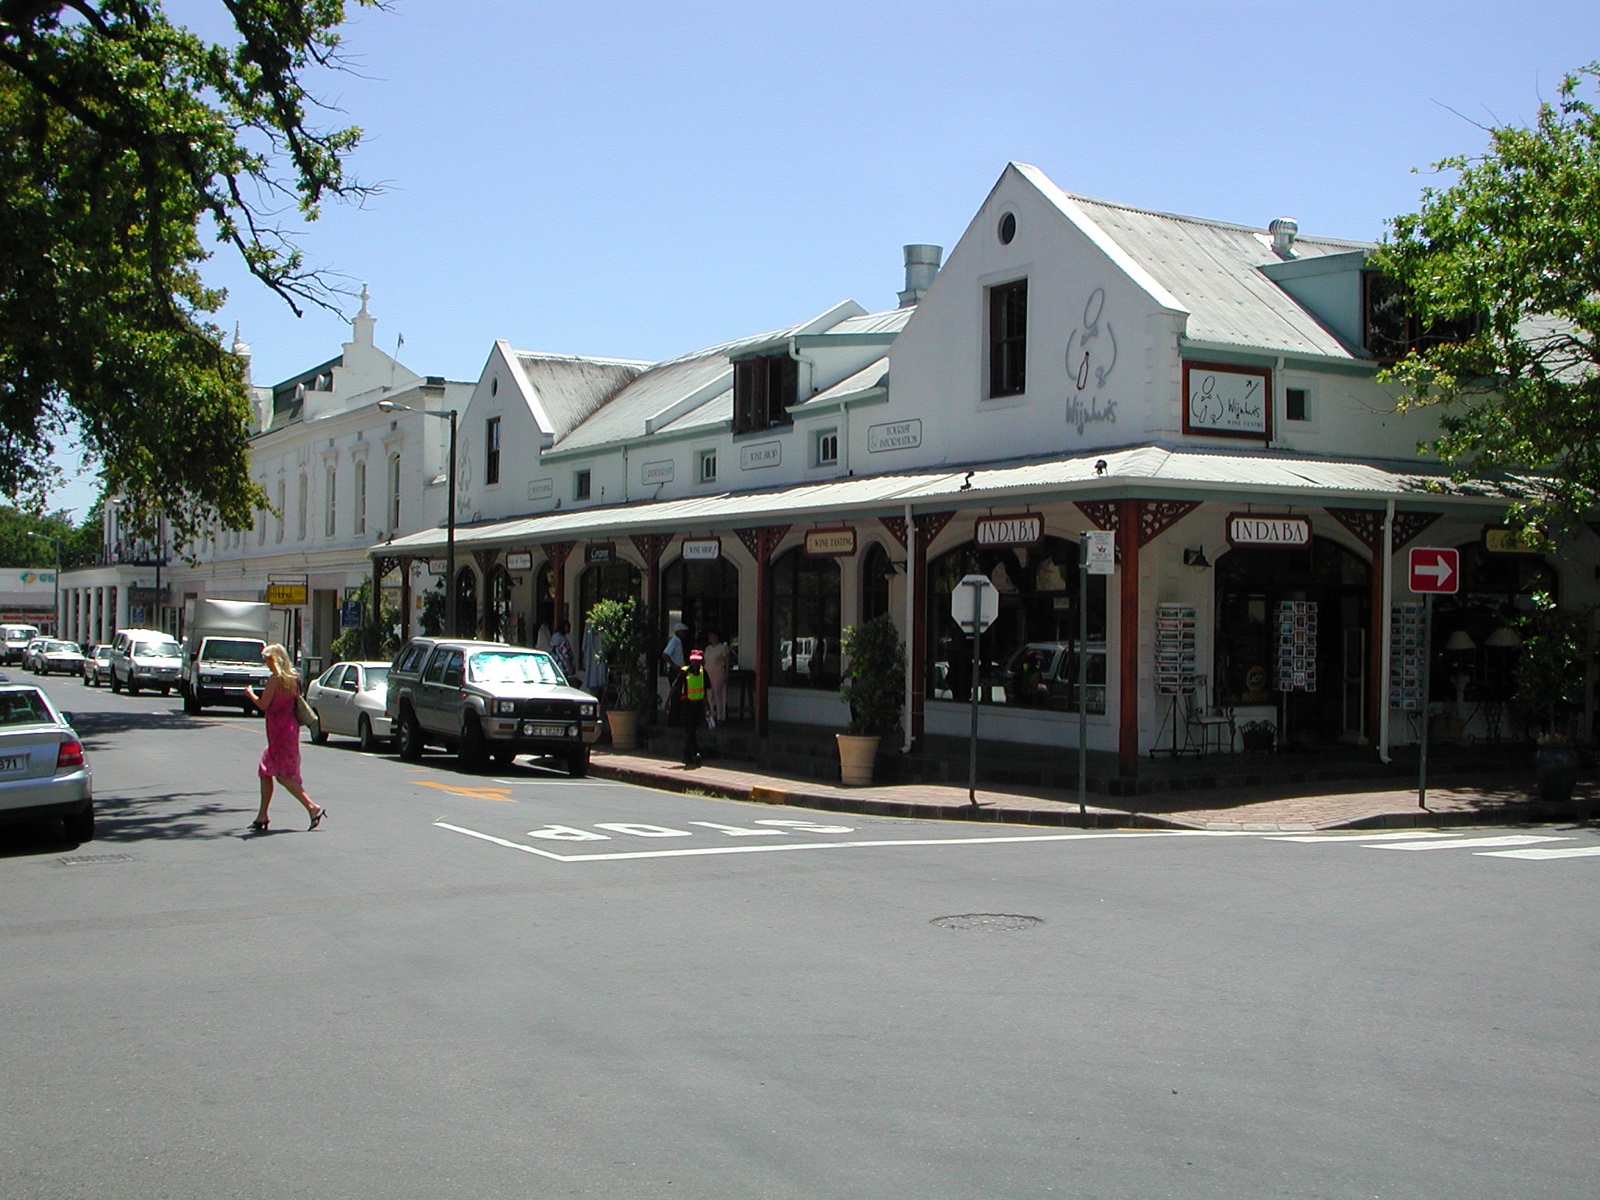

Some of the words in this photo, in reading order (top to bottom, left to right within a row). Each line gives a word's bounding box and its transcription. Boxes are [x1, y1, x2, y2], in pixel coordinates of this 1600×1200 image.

[1228, 398, 1261, 420] Wijnhuis
[879, 435, 918, 448] INFORMATION
[750, 452, 763, 461] WINE
[763, 449, 778, 460] SHOP
[982, 519, 1036, 543] INDABA
[1235, 520, 1304, 542] INDABA
[814, 539, 829, 548] WINE
[830, 537, 853, 547] TASTING
[688, 545, 701, 555] WINE
